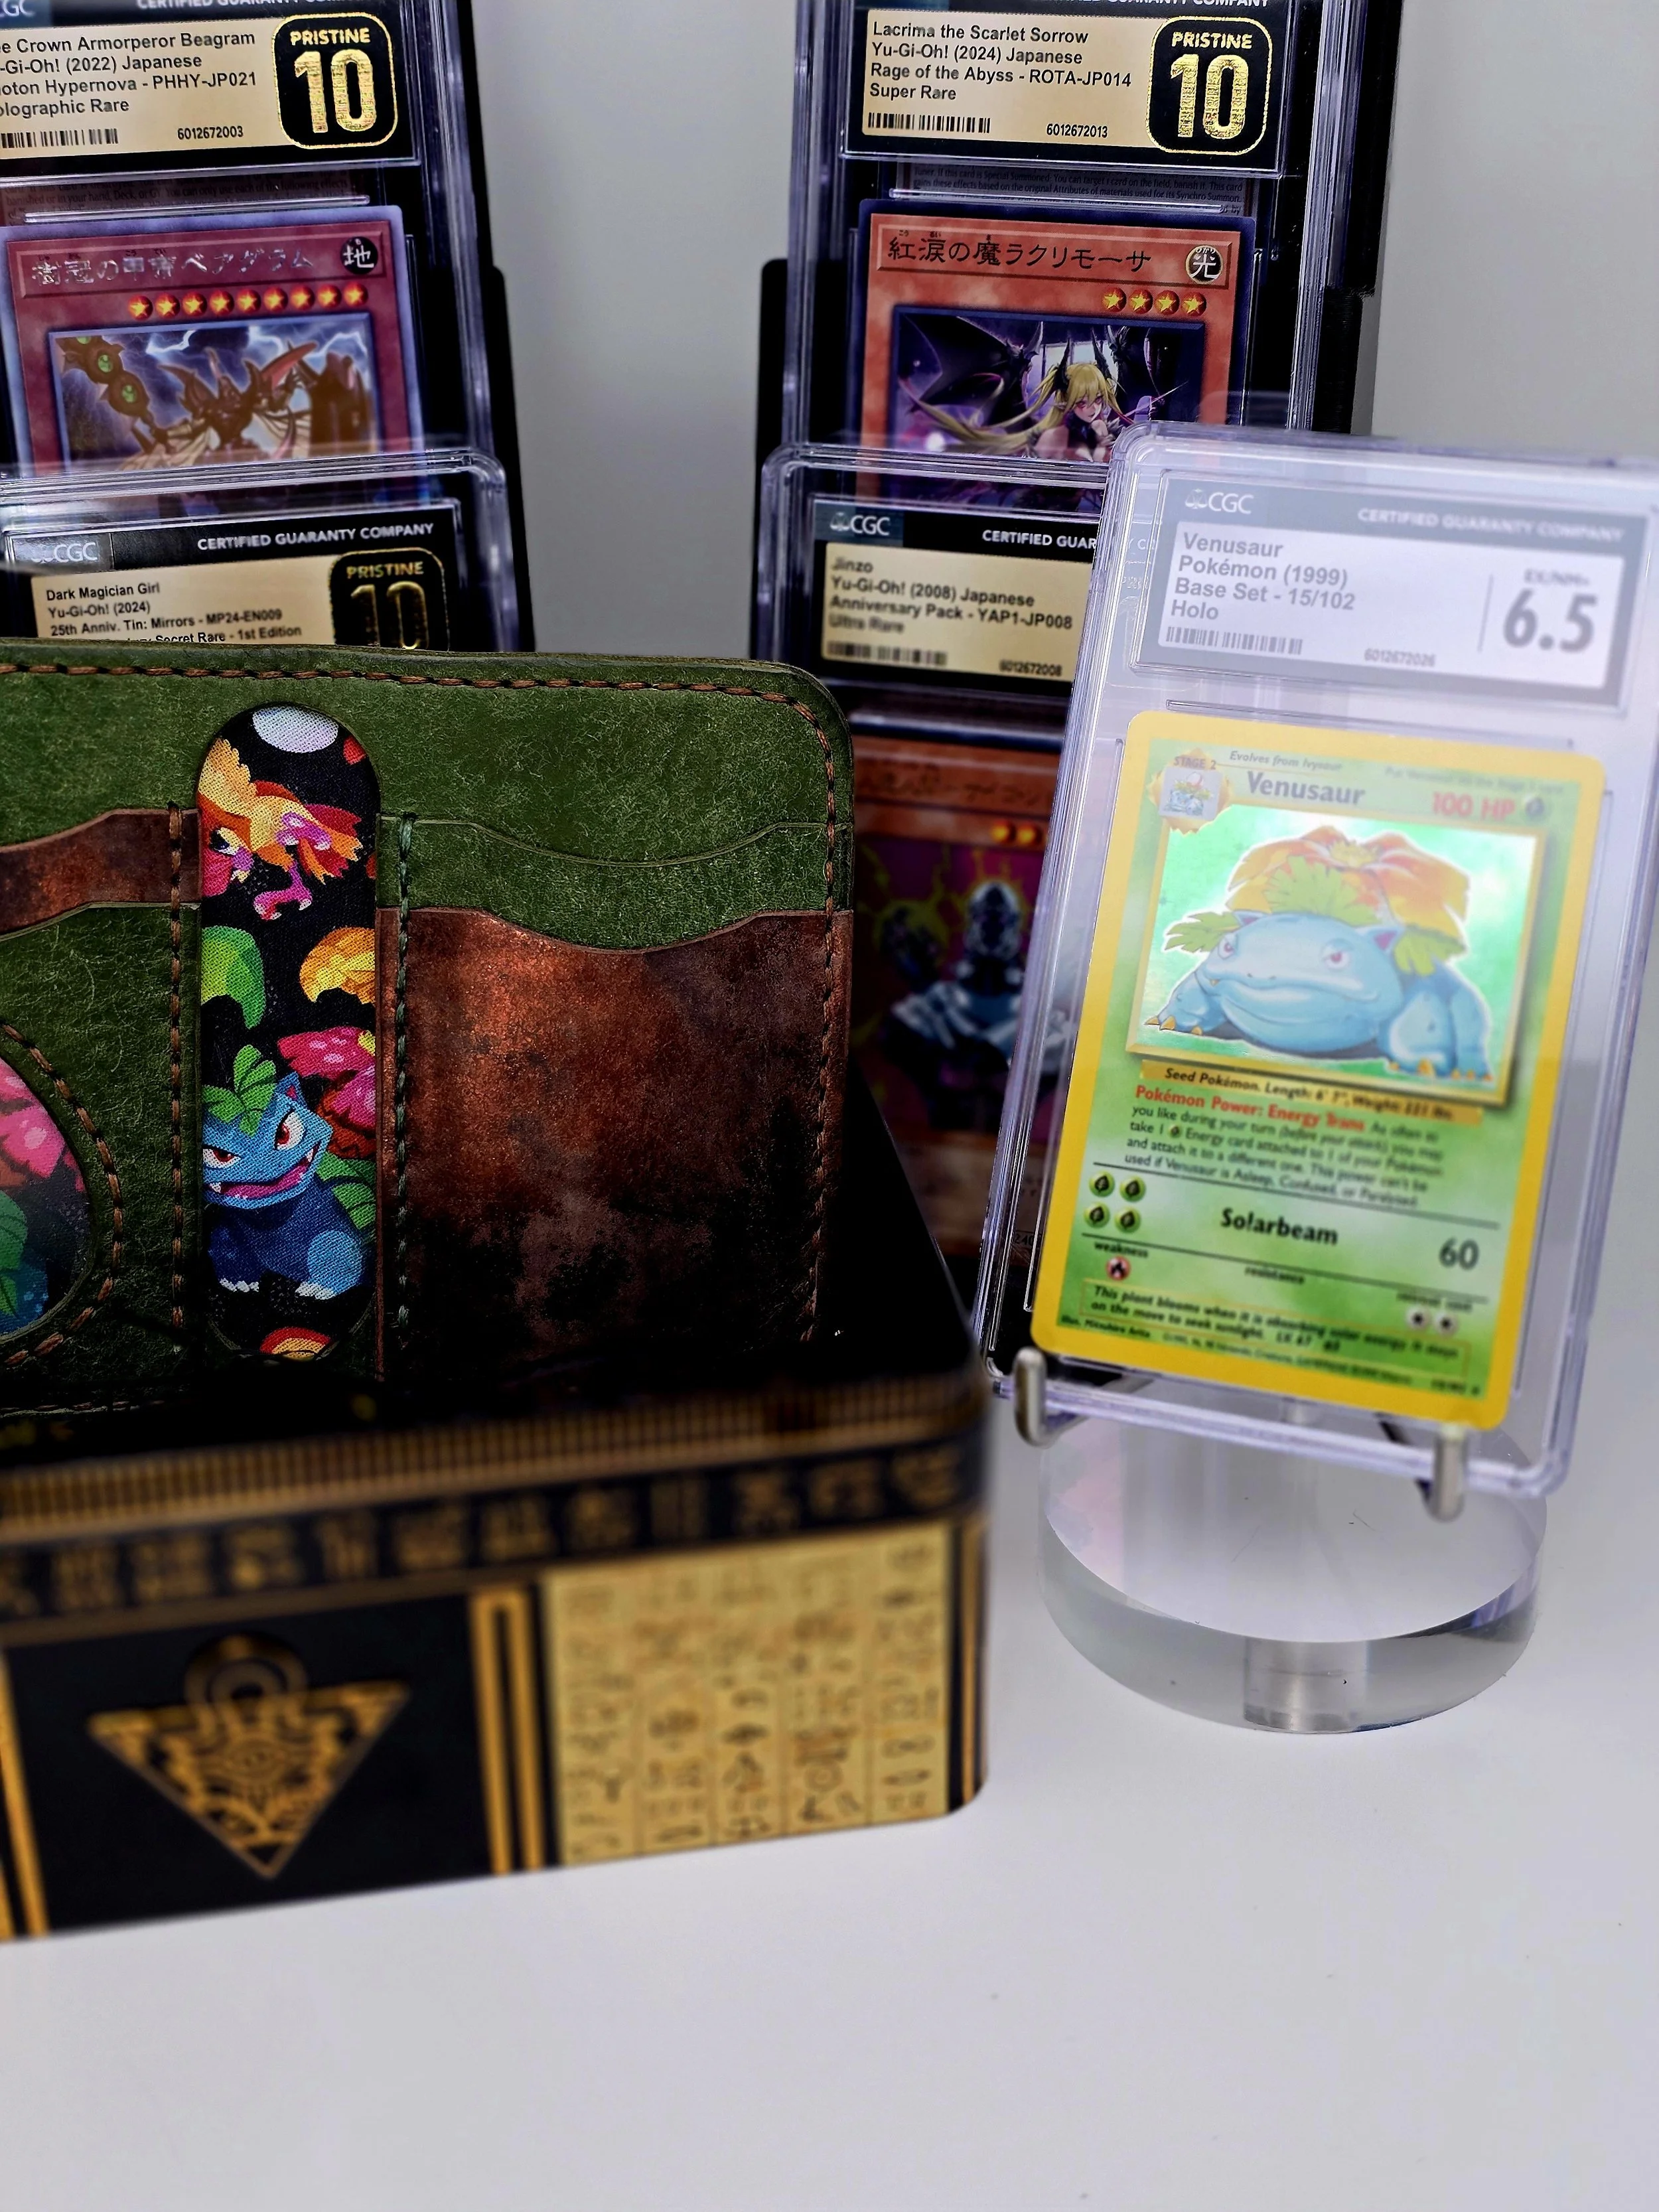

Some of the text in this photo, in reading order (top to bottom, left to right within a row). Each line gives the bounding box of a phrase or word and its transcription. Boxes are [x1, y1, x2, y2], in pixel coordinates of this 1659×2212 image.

[0, 0, 35, 17] GC
[17, 38, 72, 53] Crown
[78, 35, 176, 52] Armorperor
[180, 32, 255, 49] Beagram
[290, 28, 370, 46] PRISTINE
[873, 21, 1088, 44] Lacrima the Scarlet Sorrow
[1171, 32, 1253, 49] PRISTINE
[66, 56, 117, 76] (2022)
[121, 54, 202, 71] Japanese
[872, 42, 1082, 66] Yu-Gi-Oh! (2024) Japanese
[0, 82, 40, 95] oton
[45, 79, 137, 97] Hypernova
[152, 72, 256, 89] PHHY-JP021
[871, 62, 910, 80] Rage
[915, 65, 931, 78] of
[935, 66, 958, 80] the
[964, 67, 1013, 84] Abyss
[1029, 69, 1131, 87] ROTA-JP014
[295, 48, 376, 133] 10
[870, 82, 956, 100] Super Rare
[1171, 54, 1248, 139] 10
[90, 98, 129, 112] Rare
[177, 125, 244, 140] 6012672003
[1046, 123, 1108, 139] 6012672013
[343, 244, 375, 267] 地
[888, 236, 1151, 272] 紅涙の魔ラクリモーサ
[1192, 252, 1218, 279] 光
[1208, 492, 1254, 514] CGC
[1358, 508, 1439, 528] CERTIFIED
[1441, 515, 1534, 535] GUARANTY
[54, 523, 434, 563] CGC CERTIFIED GUARANTY COMPANY
[850, 515, 1097, 550] CGC CERTIFIED GUAR
[1183, 532, 1283, 557] Venusaur
[346, 561, 424, 579] PRISTINE
[831, 558, 873, 572] Jinzo
[1179, 555, 1348, 590] Pokémon (1999)
[46, 583, 160, 601] Dark Magician Girl
[831, 576, 1035, 607] Yu-Gi-Oh! (2008) Japanese
[1175, 577, 1226, 598] Base
[1233, 583, 1267, 602] Set
[1288, 588, 1356, 611] 15/102
[48, 601, 151, 619] Yu-Gi-Oh! (2024)
[350, 581, 429, 650] 10
[830, 596, 922, 619] Anniversary
[926, 603, 963, 619] Pack
[977, 609, 1072, 629] YAP1-JP008
[1171, 599, 1219, 621] Holo
[1503, 587, 1598, 653] 6.5
[51, 624, 77, 636] 25th
[82, 622, 120, 634] Anniv.
[123, 619, 147, 630] Tin:
[151, 616, 194, 629] Mirrors
[206, 609, 283, 625] MP24-EN009
[198, 632, 226, 643] Rare
[238, 628, 256, 640] 1st
[259, 625, 302, 638] Edition
[869, 617, 904, 632] Rare
[1173, 756, 1216, 770] STAGE 2
[1230, 751, 1269, 764] Evolves
[1273, 755, 1299, 767] from
[1247, 770, 1366, 806] Venusaur
[1432, 791, 1516, 822] 100 HP
[1165, 1068, 1196, 1083] Seed
[1199, 1072, 1261, 1092] Pokémon.
[1132, 1106, 1154, 1118] you
[1157, 1106, 1177, 1121] like
[1181, 1112, 1216, 1129] during
[1135, 1084, 1205, 1108] Pokémon
[1211, 1096, 1263, 1116] Power:
[1268, 1104, 1320, 1128] Energy
[1130, 1120, 1155, 1134] take
[1185, 1128, 1224, 1146] Energy
[1127, 1138, 1148, 1149] and
[1151, 1141, 1185, 1155] attach
[1124, 1153, 1151, 1166] used
[1154, 1155, 1163, 1167] if
[1094, 1242, 1148, 1258] weakness
[1220, 1207, 1479, 1270] Solarbeam 60
[1095, 1286, 1118, 1299] This
[1121, 1291, 1153, 1305] plant
[1090, 1301, 1107, 1311] on
[1110, 1302, 1129, 1315] the
